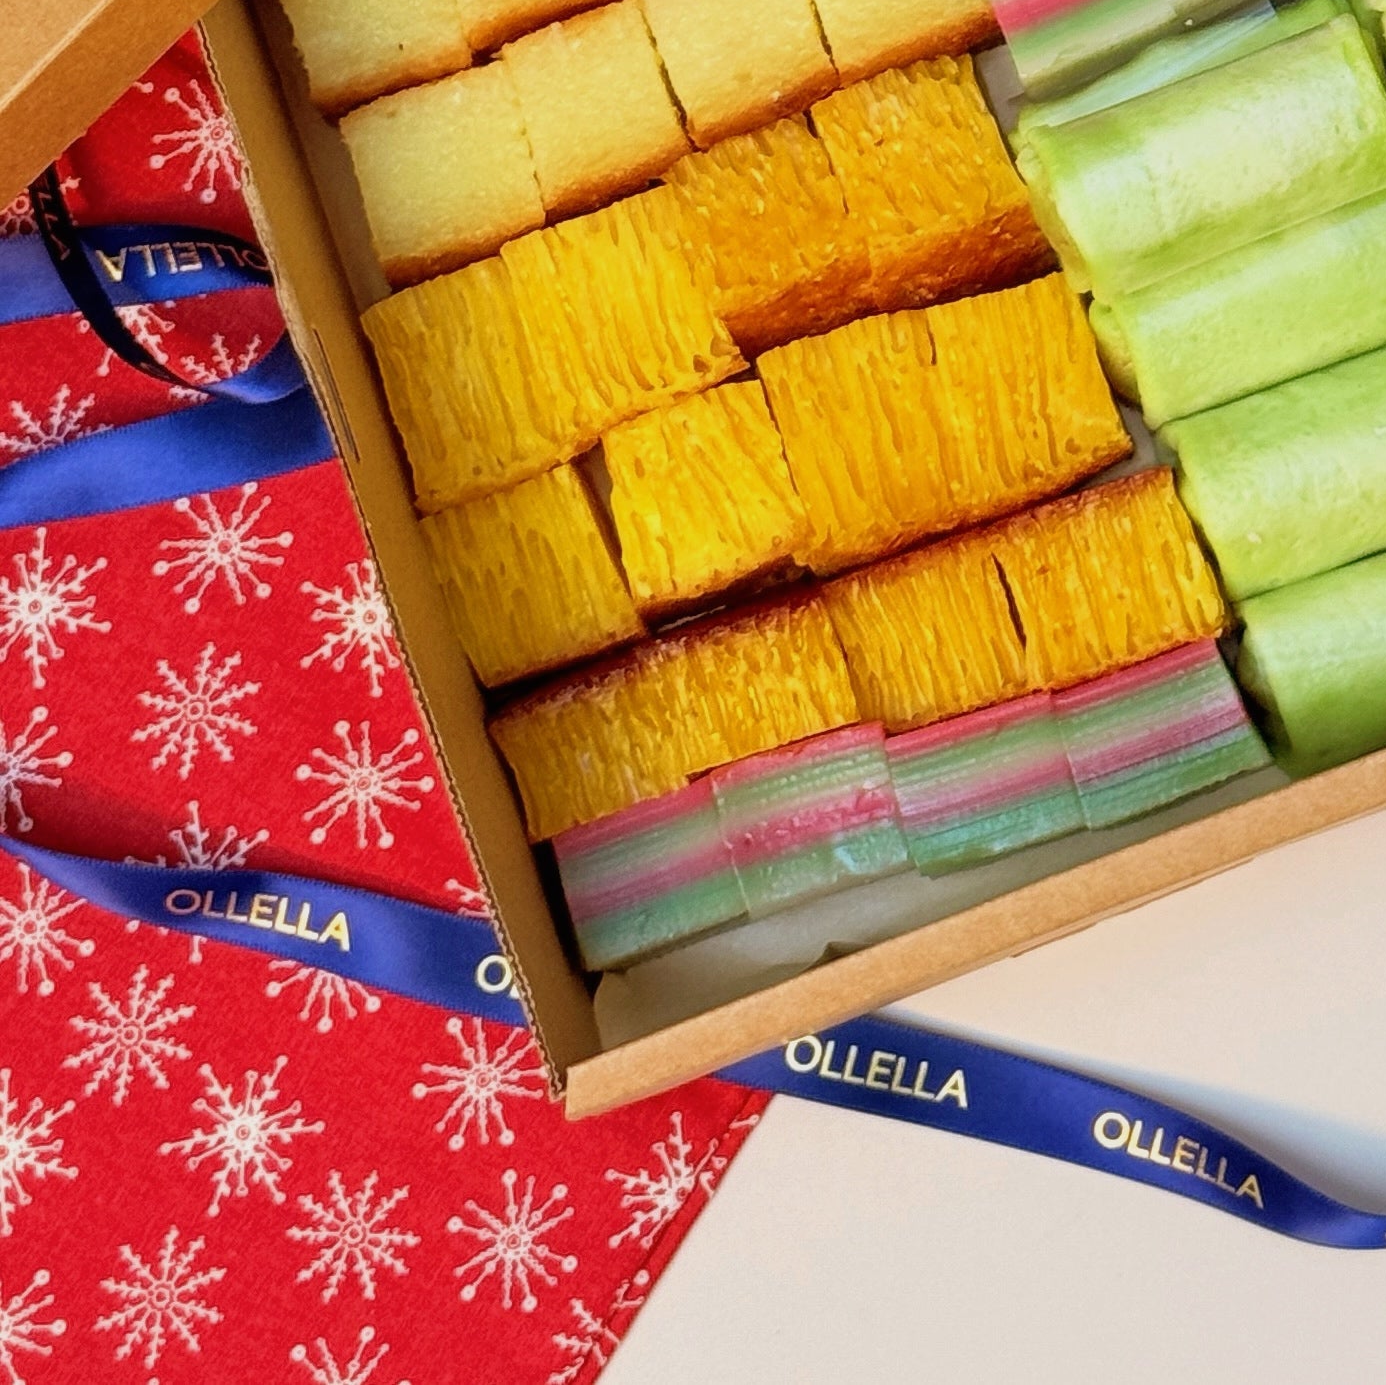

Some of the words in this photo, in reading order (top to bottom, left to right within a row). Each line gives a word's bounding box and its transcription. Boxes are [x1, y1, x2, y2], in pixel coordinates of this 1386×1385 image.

[95, 242, 271, 282] OLLELLA
[165, 889, 350, 952] OLLELLA
[785, 1035, 968, 1109] OLLELLA
[1093, 1111, 1264, 1210] OLLELLA
